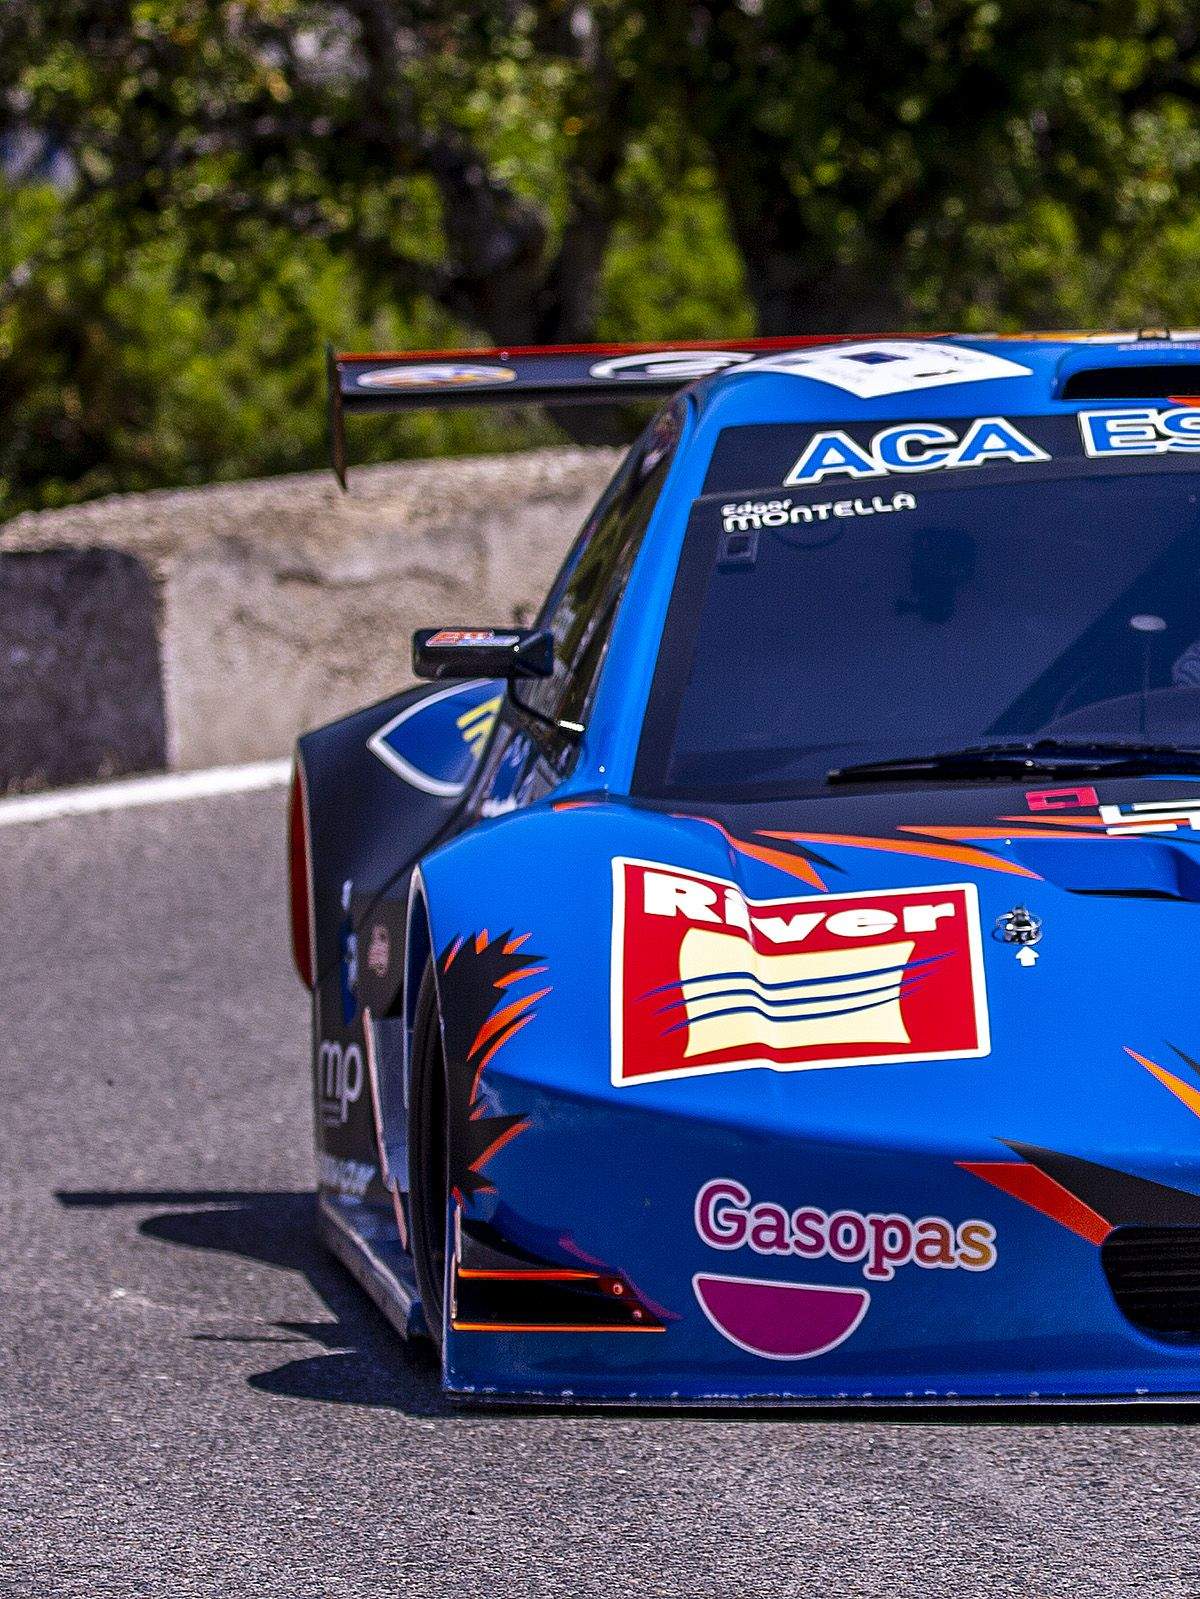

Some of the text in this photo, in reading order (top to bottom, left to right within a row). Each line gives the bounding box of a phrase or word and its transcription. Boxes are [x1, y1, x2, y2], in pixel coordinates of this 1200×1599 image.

[784, 417, 1051, 486] ACA
[643, 871, 956, 944] River
[694, 1178, 997, 1280] Gasopas
